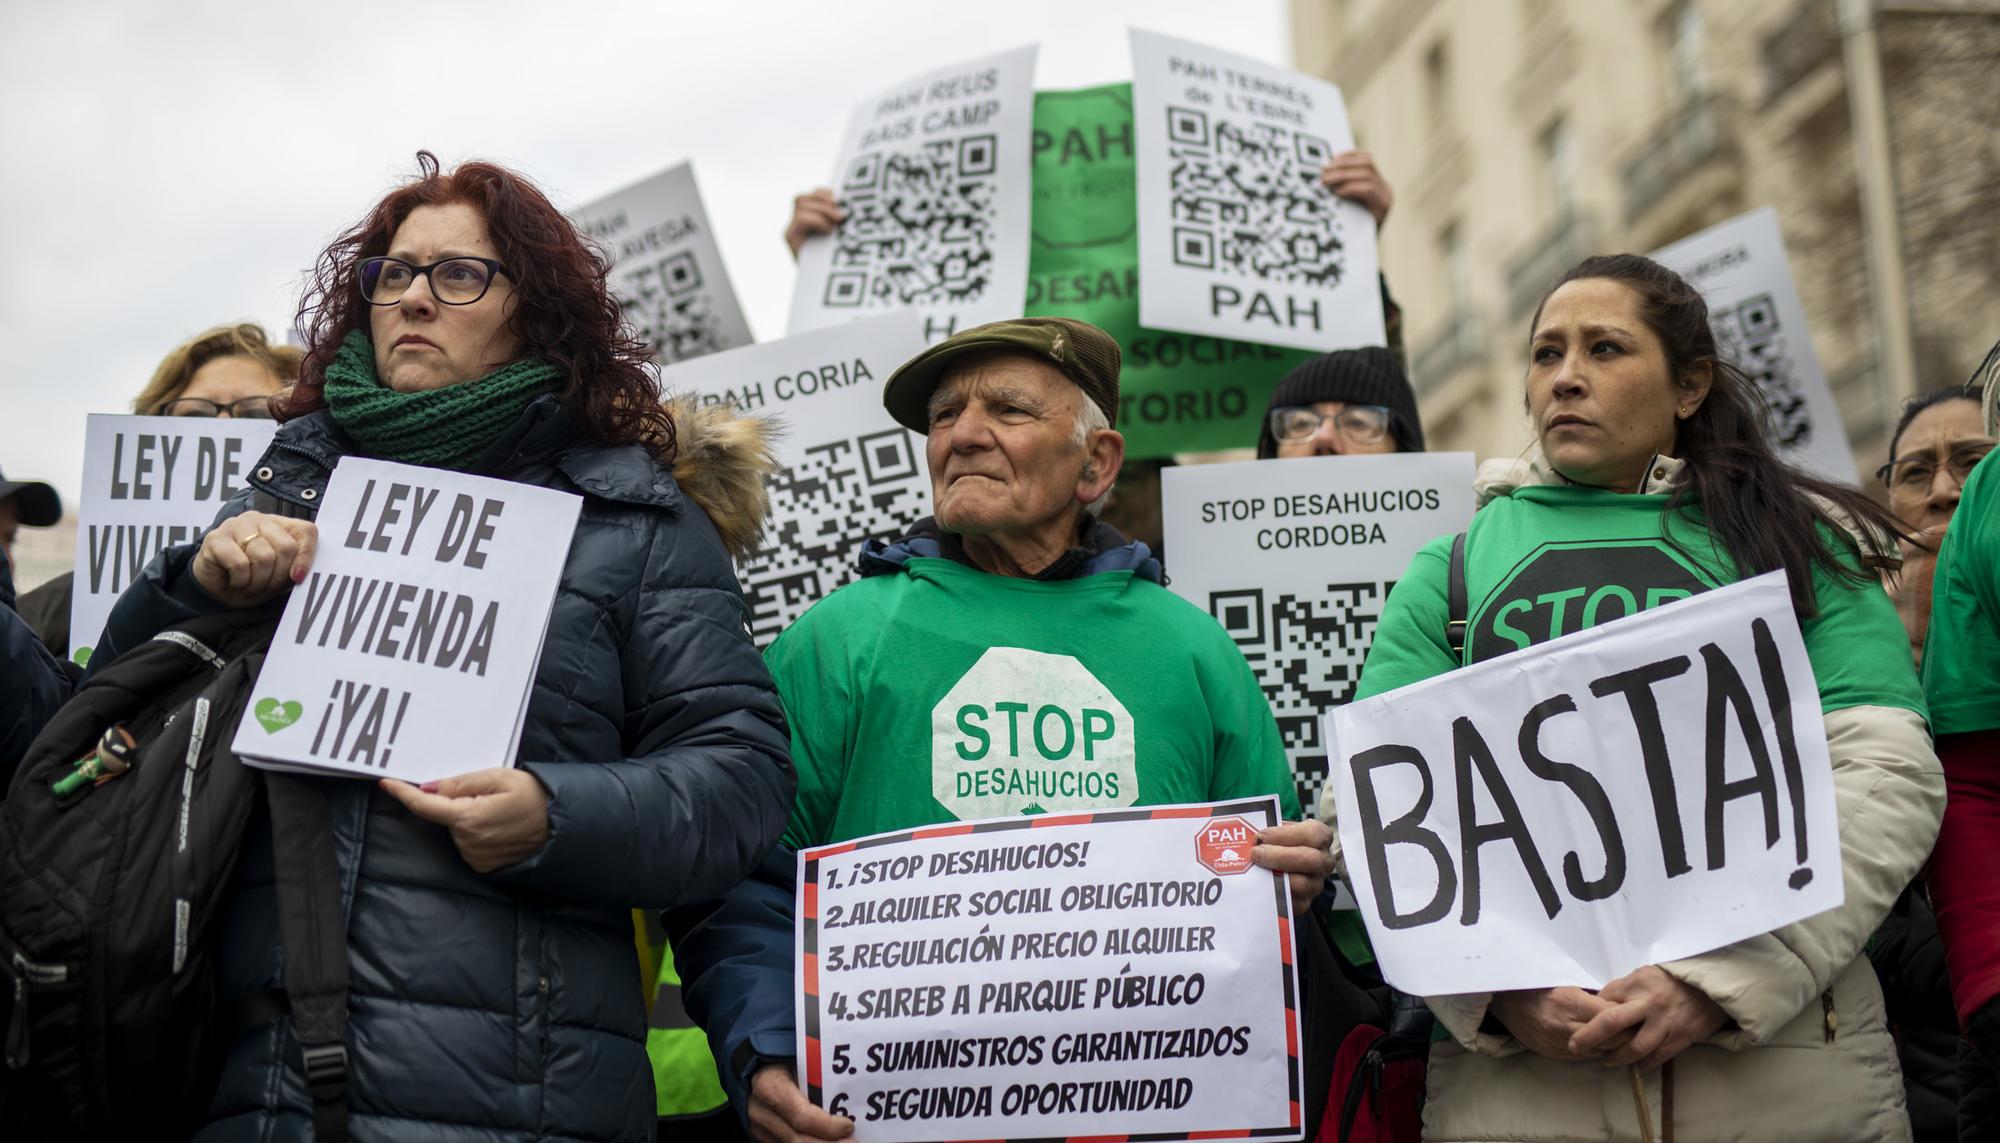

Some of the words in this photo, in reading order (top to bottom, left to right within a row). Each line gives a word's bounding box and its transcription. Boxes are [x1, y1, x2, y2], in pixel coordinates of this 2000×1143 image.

[921, 101, 1001, 132] CAMP
[1031, 123, 1132, 167] PAH
[1028, 270, 1139, 306] DESA
[1211, 283, 1322, 331] PAH
[774, 358, 873, 400] CORIA
[1120, 386, 1248, 425] TORIO
[111, 433, 183, 500] LEY
[194, 437, 242, 502] DE
[344, 479, 440, 556] LEY
[435, 493, 505, 569] DE
[1202, 498, 1265, 524] STOP
[1274, 489, 1440, 518] DESAHUCIOS
[1257, 523, 1386, 551] CORDOBA
[294, 571, 499, 677] VIVIENDA
[310, 679, 412, 769] ¡YA!
[955, 702, 1115, 761] STOP
[956, 768, 1119, 799] DESAHUCIOS
[1350, 617, 1814, 930] BASTA!
[1208, 827, 1246, 843] PAH
[827, 868, 843, 890] 1.
[849, 858, 923, 886] ¡STOP
[930, 841, 1091, 878] DESAHUCIOS!
[824, 894, 961, 929] 2.ALQUILER
[969, 887, 1052, 917] SOCIAL
[1061, 878, 1223, 911] OBLIGATORIO
[826, 924, 1004, 972] 3.REGULACIÓN
[1011, 930, 1097, 960] PRECIO
[1103, 926, 1216, 955] ALQUILER
[828, 985, 944, 1021] 4.SAREB
[951, 984, 970, 1014] A
[978, 979, 1087, 1013] PARQUE
[1094, 963, 1205, 1010] PÚBLICO
[833, 1045, 857, 1074] 5.
[865, 1035, 1045, 1073] SUMINISTROS
[1052, 1026, 1250, 1065] GARANTIZADOS
[829, 1092, 857, 1123] 6.
[865, 1085, 992, 1122] SEGUNDA
[1001, 1077, 1193, 1116] OPORTUNIDAD
